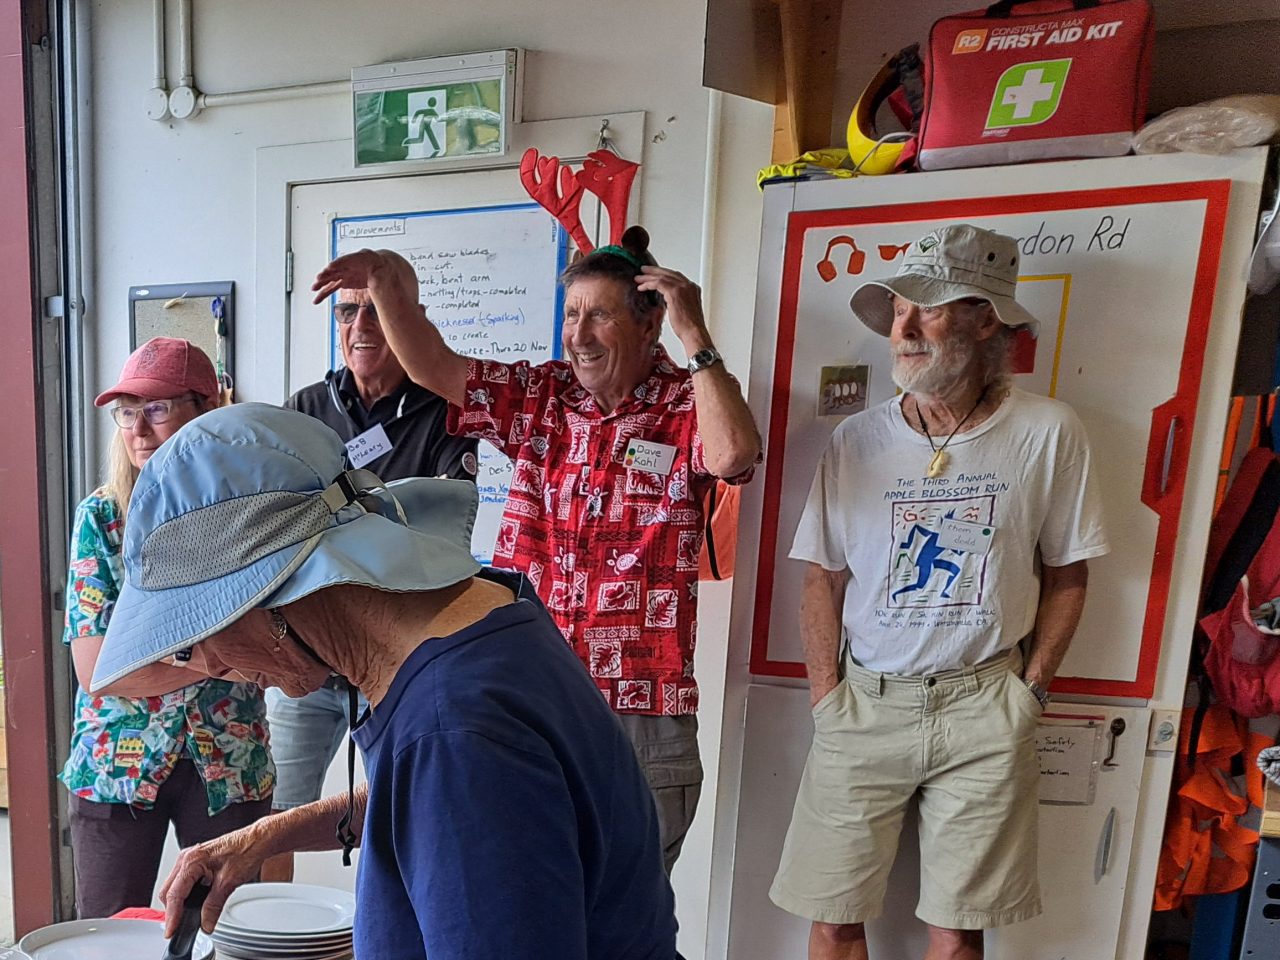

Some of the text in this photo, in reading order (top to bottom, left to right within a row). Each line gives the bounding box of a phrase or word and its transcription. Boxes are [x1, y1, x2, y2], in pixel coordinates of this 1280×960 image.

[991, 17, 1085, 36] CONSTRUCTA MAX
[957, 34, 981, 47] R2
[986, 20, 1123, 51] FIRST AID KIT
[341, 221, 401, 236] Improvements
[1087, 215, 1130, 251] Rd
[513, 342, 527, 352] 20
[531, 341, 548, 352] Nov
[636, 445, 662, 458] Dave
[634, 456, 657, 468] Kahl
[489, 466, 505, 476] Dec
[896, 472, 997, 487] THE THIRD ANNUAL
[884, 482, 1010, 500] APPLE BLOSSOM RUN
